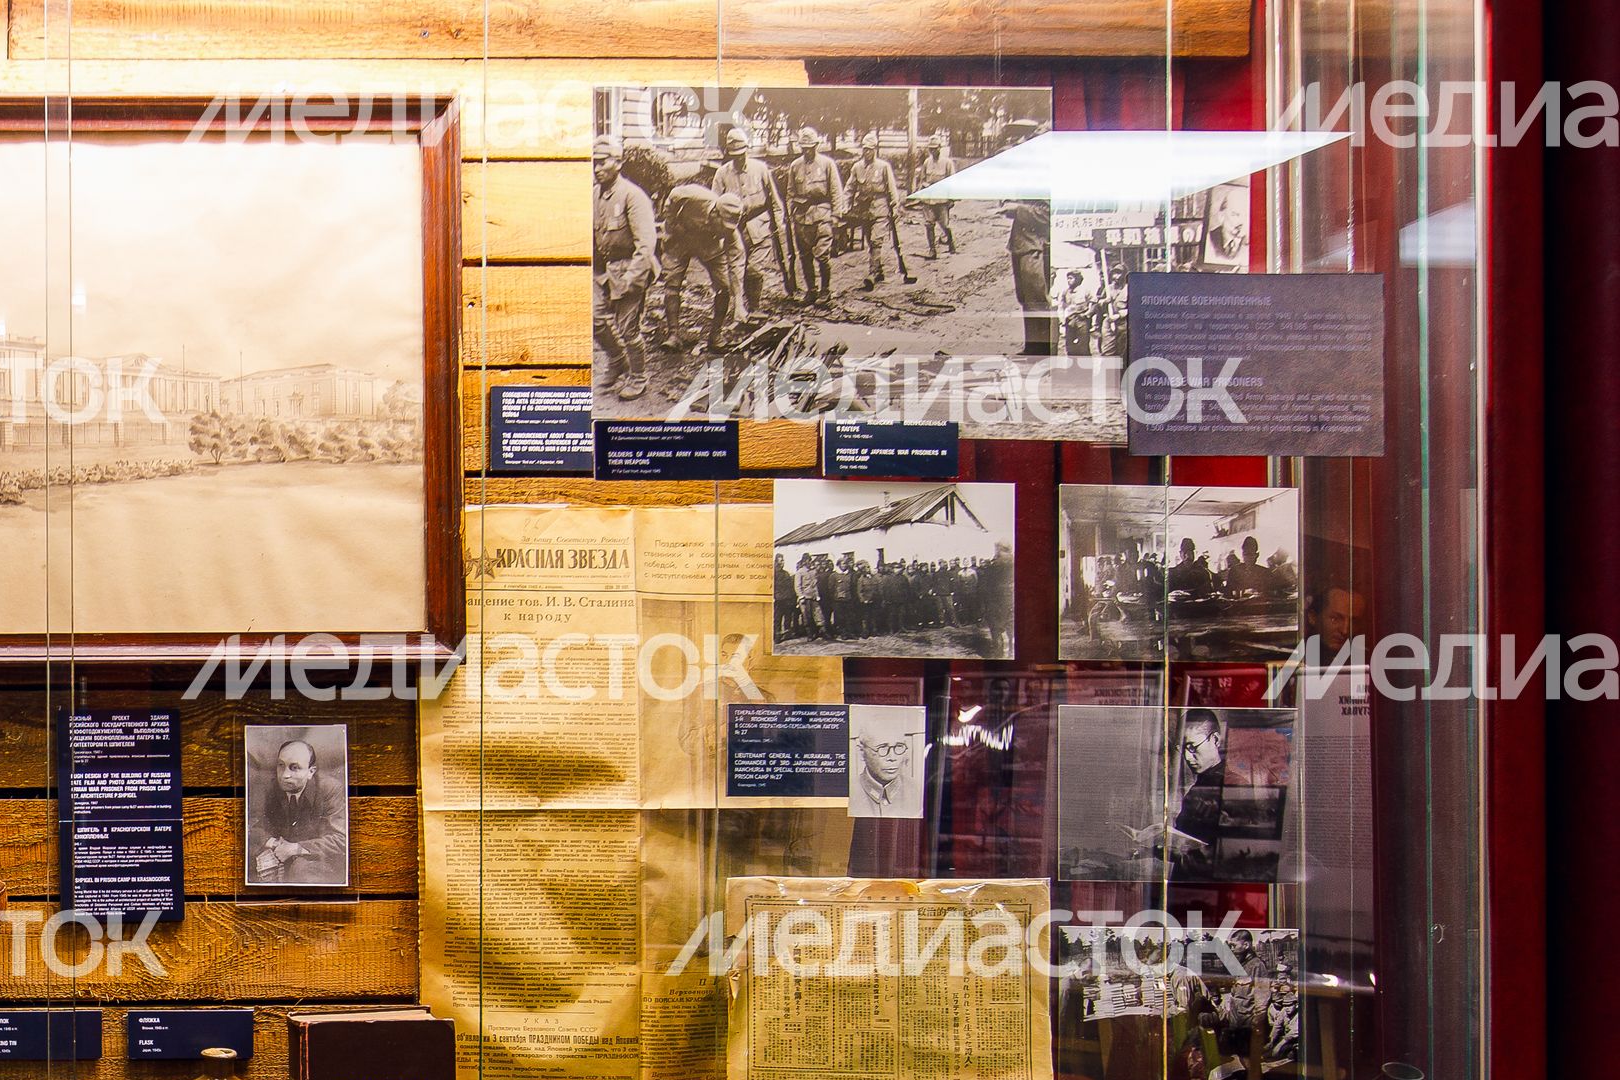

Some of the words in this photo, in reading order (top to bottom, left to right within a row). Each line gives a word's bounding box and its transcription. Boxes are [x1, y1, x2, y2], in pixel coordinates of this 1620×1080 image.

[496, 549, 564, 570] КРАСНАЯ
[571, 549, 629, 570] ЗВЕЗДА
[546, 596, 559, 606] И.
[564, 597, 575, 607] В.
[579, 597, 634, 607] Сталина
[519, 612, 572, 623] народу
[499, 1035, 526, 1044] сентября
[528, 1034, 570, 1043] ПРАЗДНИКОМ
[573, 1035, 599, 1044] ПОБЕДЫ
